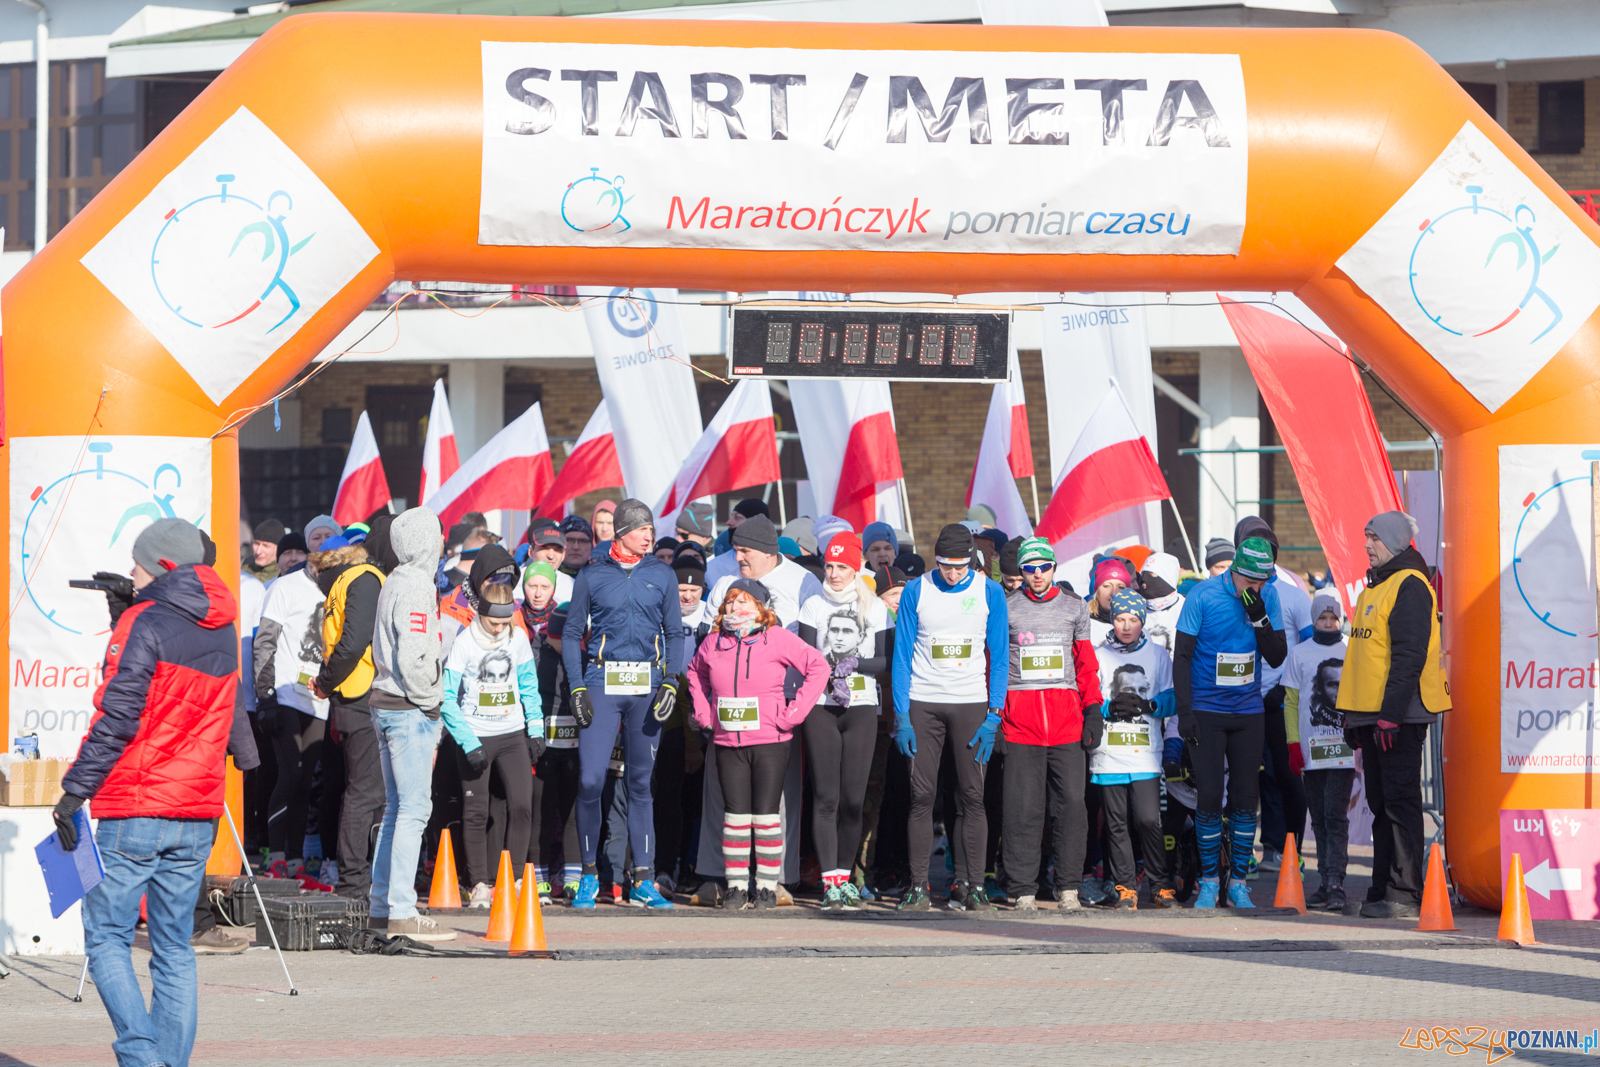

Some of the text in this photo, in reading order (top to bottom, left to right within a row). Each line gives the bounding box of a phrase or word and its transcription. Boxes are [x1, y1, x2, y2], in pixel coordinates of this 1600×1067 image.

[505, 67, 807, 140] START
[886, 75, 1232, 148] META
[666, 196, 931, 239] Maratończyk
[942, 646, 962, 655] 696
[1032, 657, 1051, 667] 881
[1232, 664, 1245, 673] 40
[618, 672, 638, 683] 566
[490, 693, 508, 704] 732
[727, 708, 746, 719] 747
[558, 727, 575, 738] 992
[1120, 733, 1137, 743] 111
[1322, 745, 1342, 756] 736
[1513, 815, 1581, 836] 4,3 km
